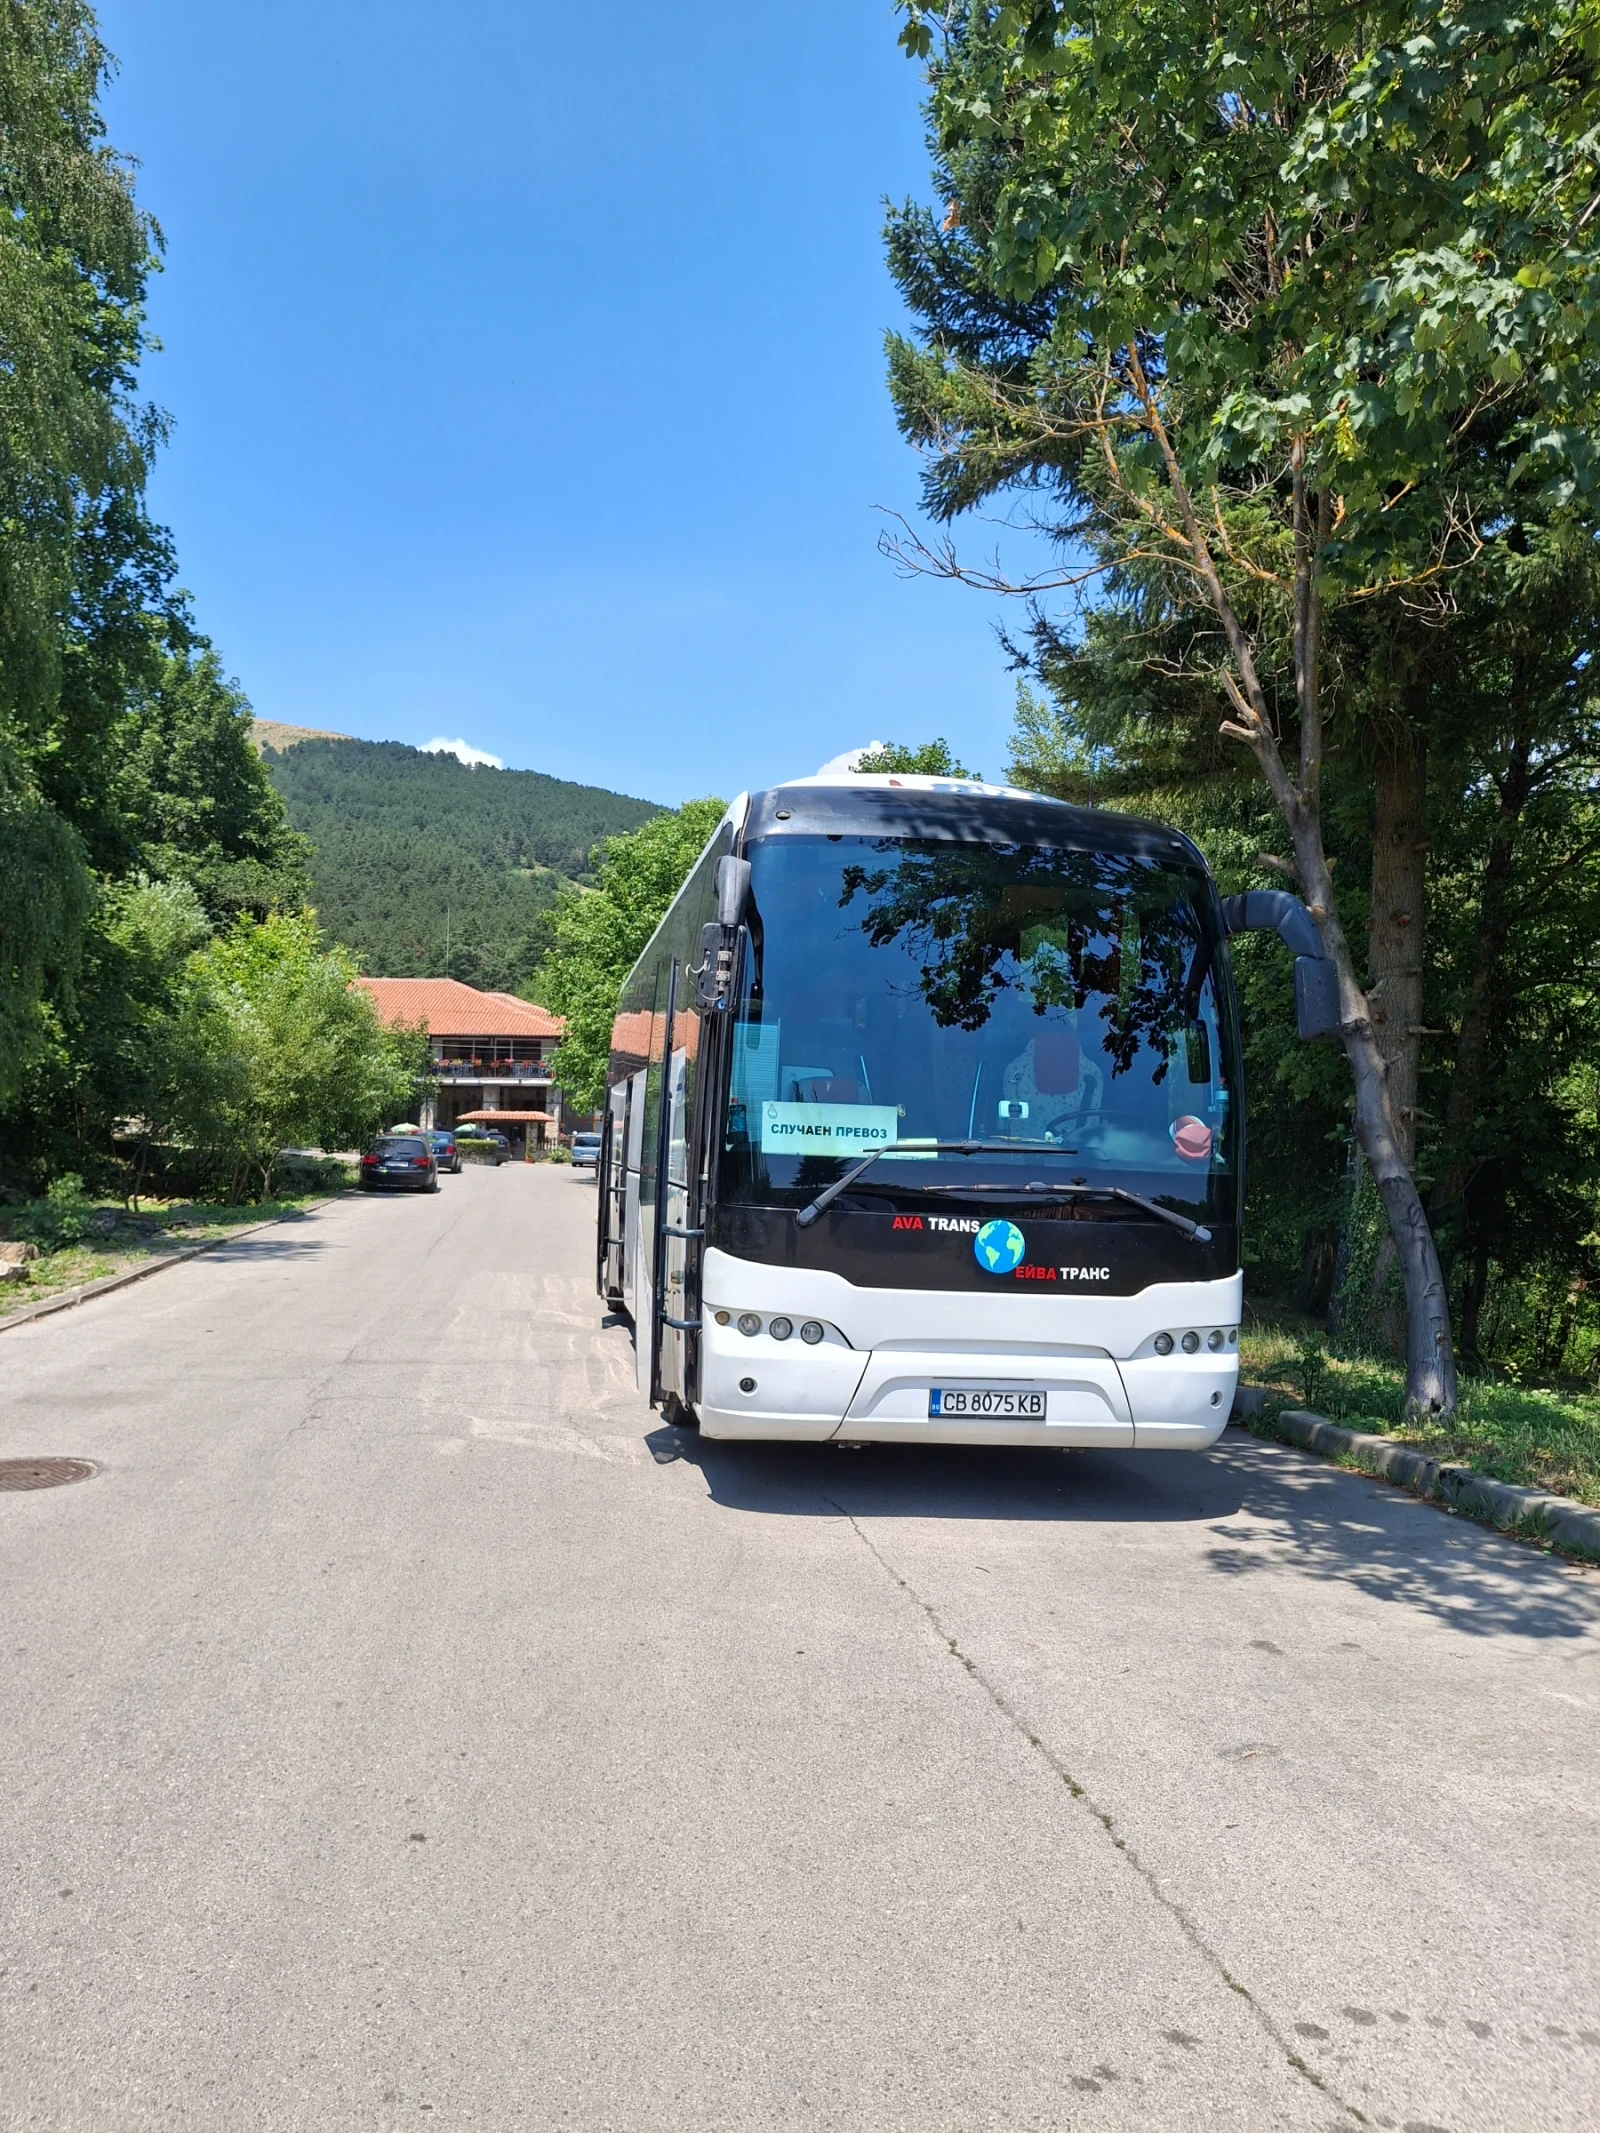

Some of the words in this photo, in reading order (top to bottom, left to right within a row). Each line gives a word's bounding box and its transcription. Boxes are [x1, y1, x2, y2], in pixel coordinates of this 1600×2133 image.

[771, 1123, 832, 1137] СЛУЧАЕН
[835, 1126, 888, 1139] ПРЕВОЗ
[892, 1216, 924, 1230] AVA
[928, 1217, 980, 1233] TRANS
[1015, 1264, 1057, 1281] ЕЙВА
[1060, 1267, 1110, 1280] ТРАНС
[943, 1393, 967, 1411] CB
[971, 1394, 1015, 1413] 8075
[1018, 1395, 1041, 1413] KB
